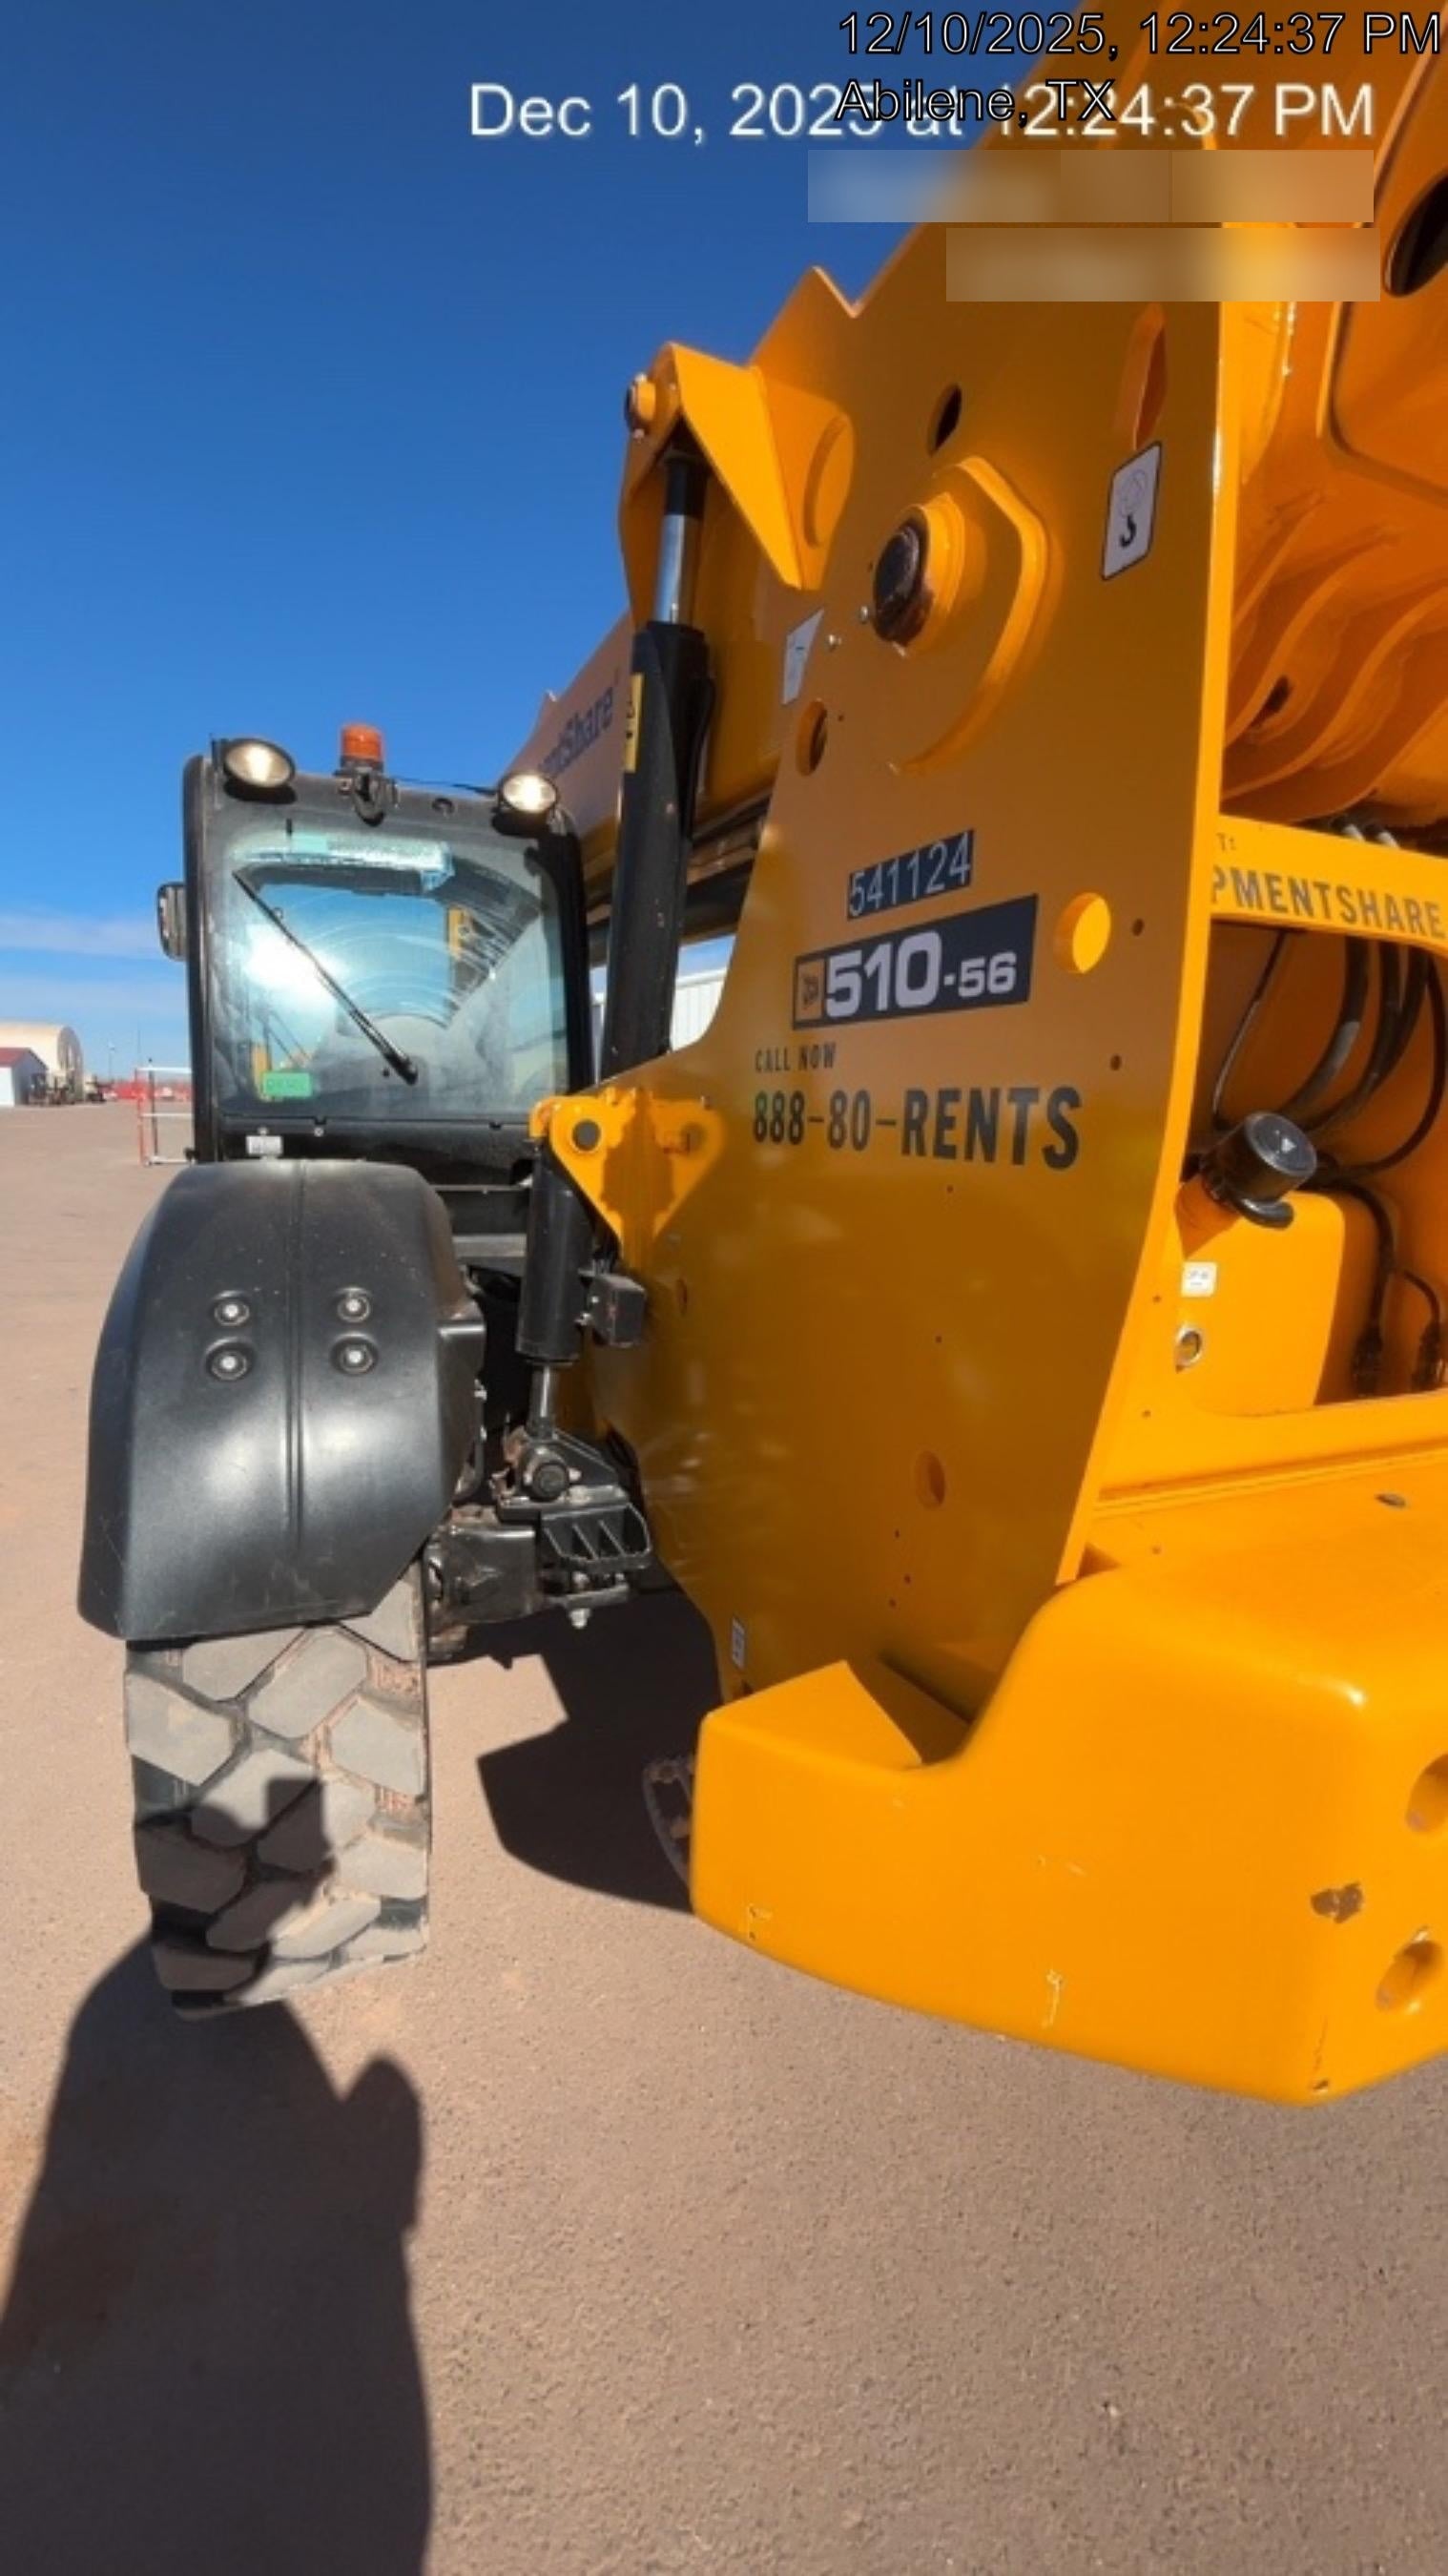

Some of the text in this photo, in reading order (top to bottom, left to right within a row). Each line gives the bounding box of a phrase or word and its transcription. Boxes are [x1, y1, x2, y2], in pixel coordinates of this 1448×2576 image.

[848, 831, 970, 917] 541124
[755, 1042, 837, 1073] CALL NOW
[753, 1085, 1082, 1171] 888-80-RENTS
